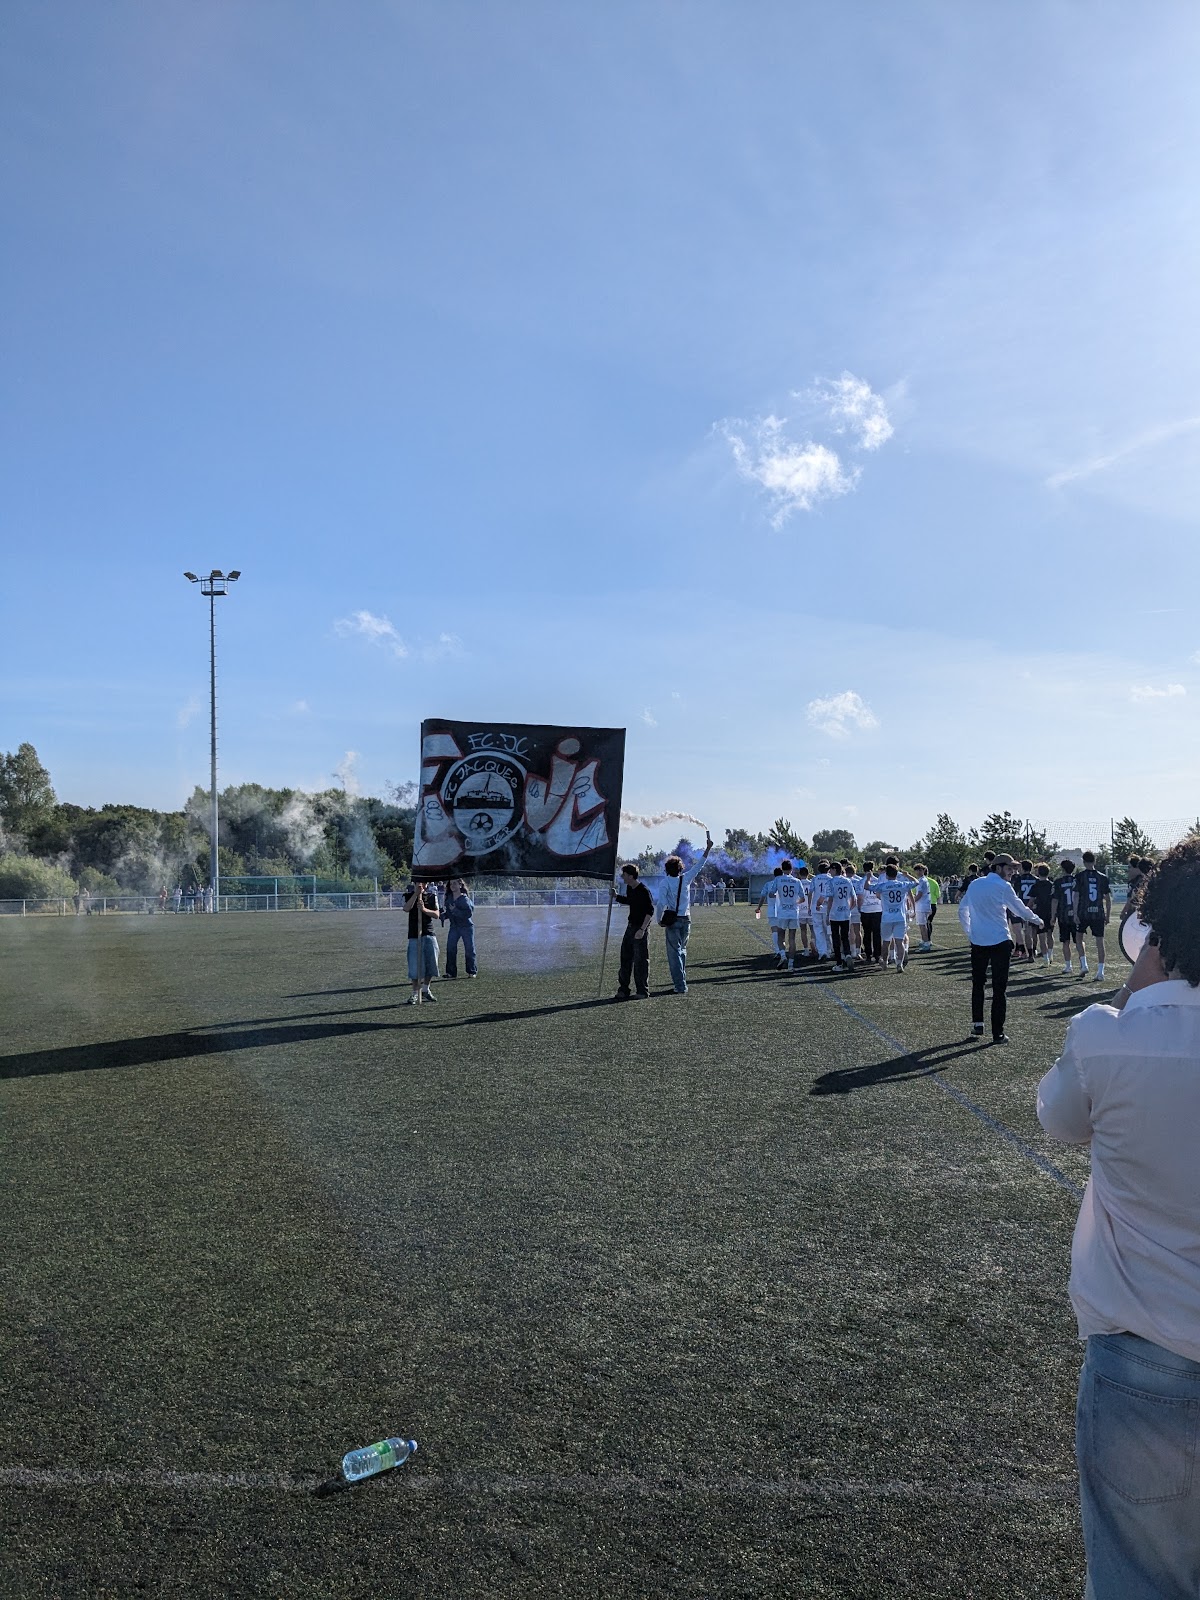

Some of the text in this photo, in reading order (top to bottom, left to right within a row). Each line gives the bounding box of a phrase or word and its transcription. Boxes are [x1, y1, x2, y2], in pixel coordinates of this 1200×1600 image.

[444, 760, 518, 801] FC JACQUES
[782, 885, 795, 898] 95
[837, 886, 848, 900] 35
[888, 890, 902, 903] 98
[1088, 883, 1098, 902] 5
